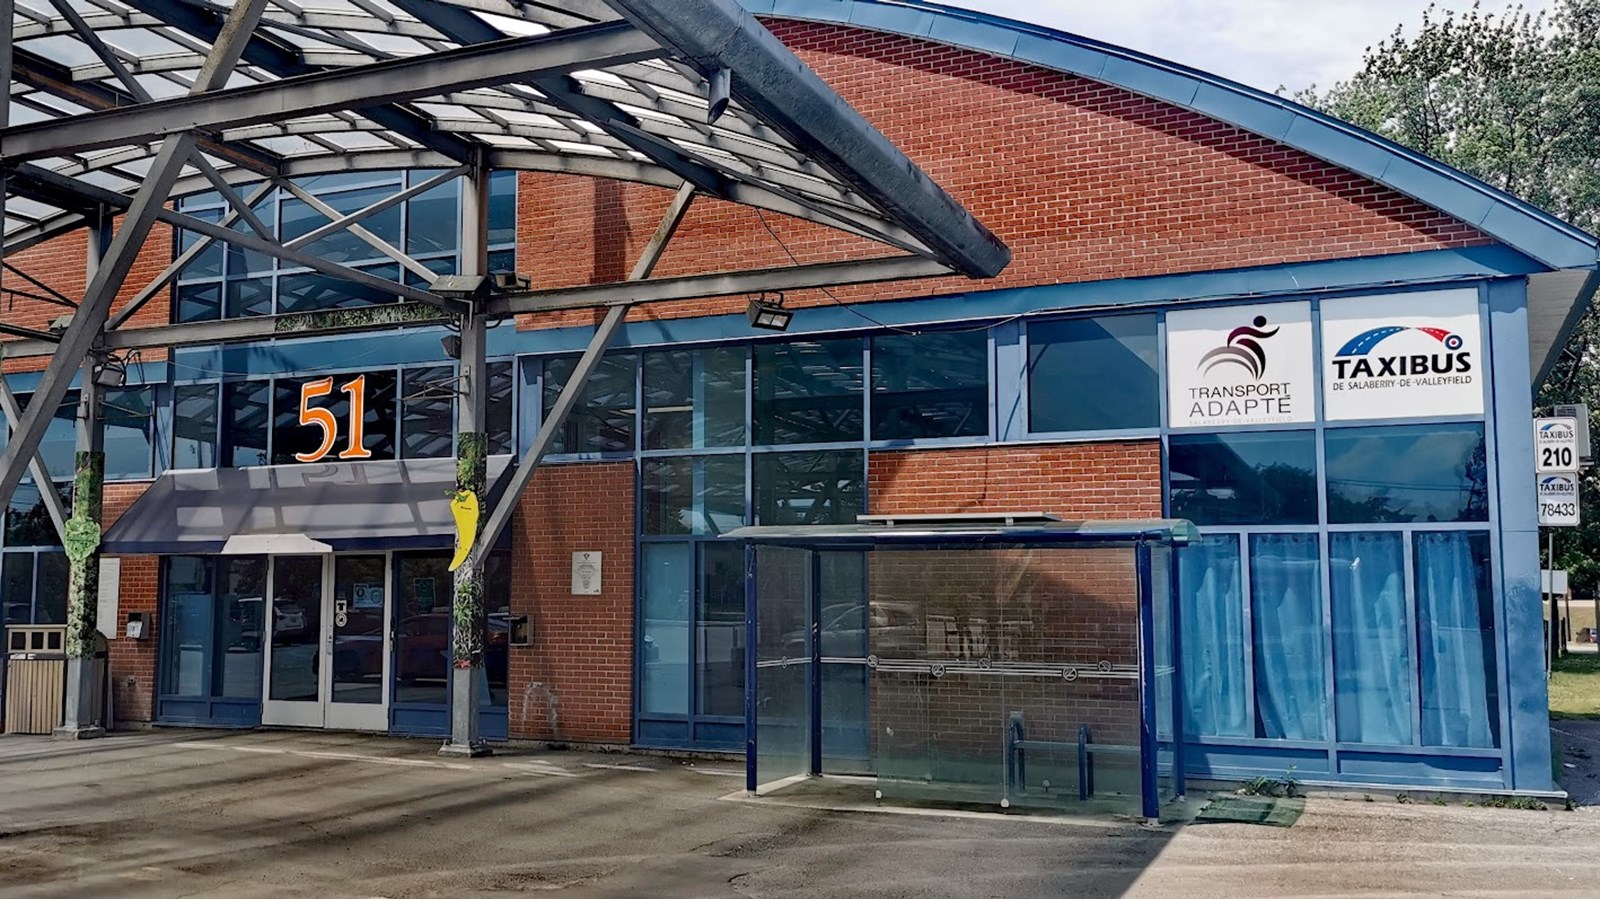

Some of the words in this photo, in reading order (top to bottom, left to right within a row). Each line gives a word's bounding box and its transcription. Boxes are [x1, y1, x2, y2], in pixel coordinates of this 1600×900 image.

[1332, 352, 1471, 379] TAXIBUS
[1188, 382, 1291, 399] TRANSPORT
[1333, 382, 1344, 391] DE
[295, 374, 371, 462] 51
[1539, 430, 1574, 439] TAXIBUS
[1542, 447, 1572, 467] 210
[1540, 483, 1574, 491] TAXIBUS
[1540, 503, 1575, 516] 78433
